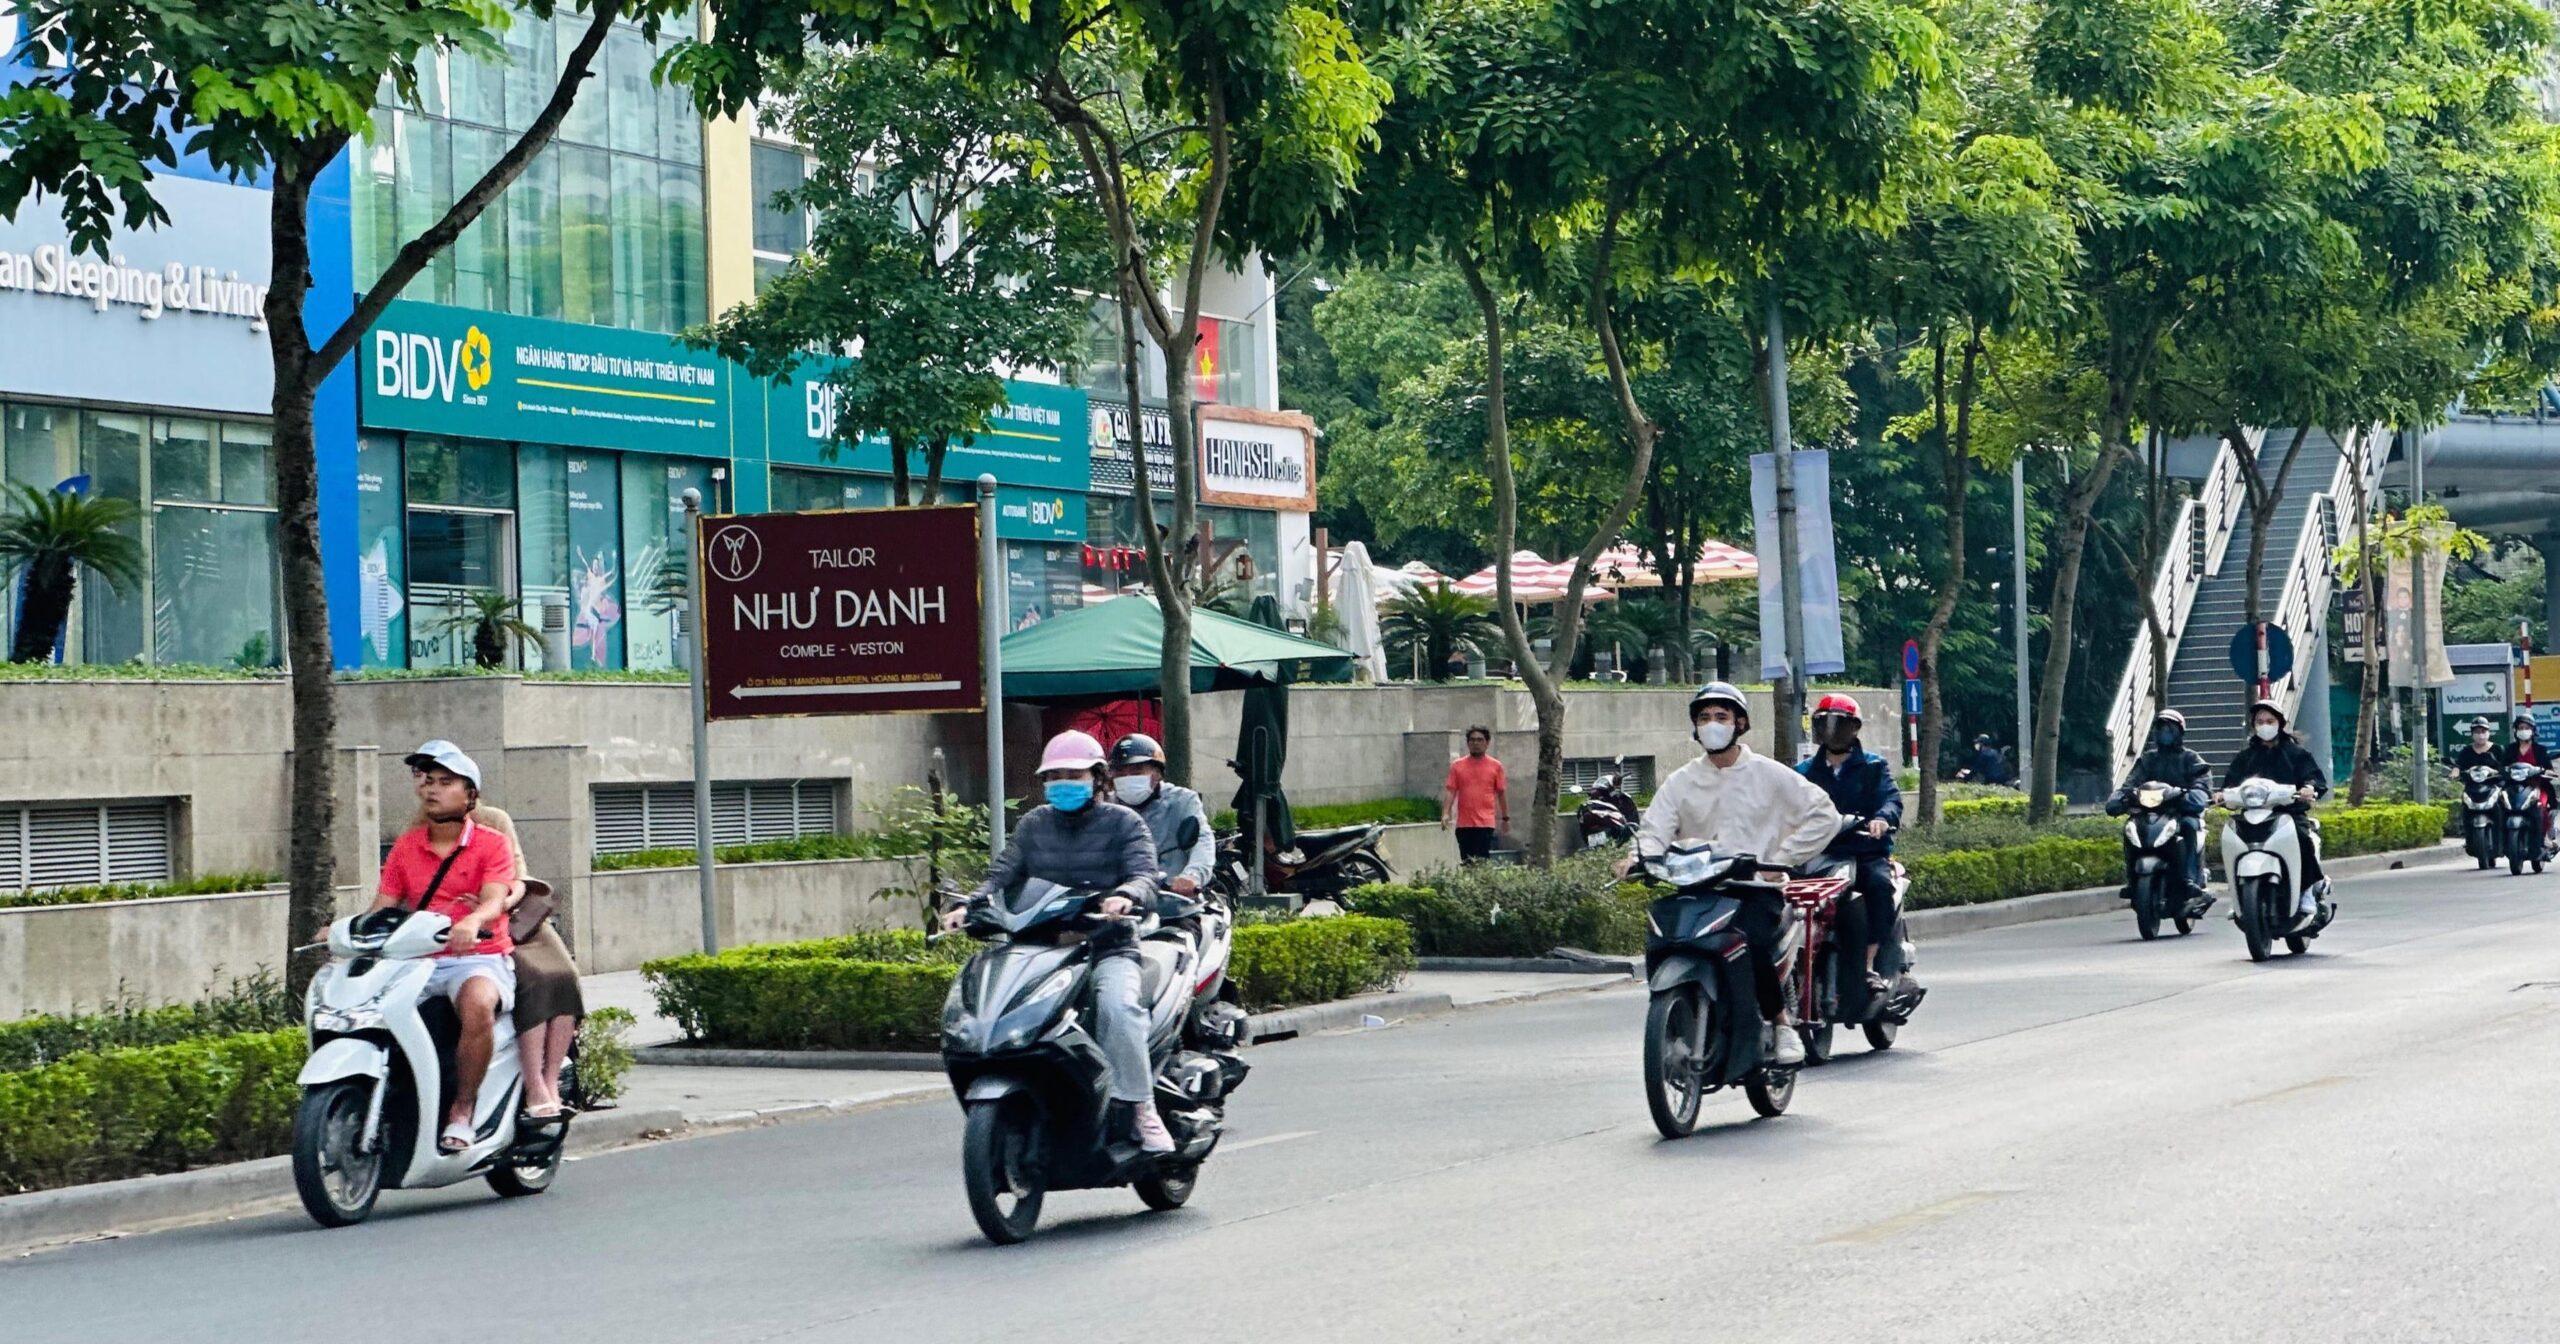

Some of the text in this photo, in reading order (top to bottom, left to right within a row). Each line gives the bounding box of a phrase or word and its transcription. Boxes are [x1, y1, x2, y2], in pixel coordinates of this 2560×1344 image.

[36, 244, 163, 320] Sleeping
[164, 261, 190, 310] &
[193, 264, 270, 333] Living
[376, 329, 463, 403] BIDV
[516, 344, 541, 366] NGÂN
[542, 346, 566, 370] HÀNG
[567, 353, 590, 374] TMCP
[634, 359, 654, 380] PHÁT
[679, 364, 696, 388] VIỆT
[697, 369, 715, 387] NAM
[1114, 410, 1156, 444] GAEN
[1208, 438, 1275, 479] HANASHI
[1032, 502, 1056, 525] BIDV
[808, 547, 876, 568] TAILOR
[733, 586, 946, 631] NHƯ DANH
[780, 645, 836, 658] COMPLE
[850, 641, 904, 656] VESTON
[2447, 694, 2502, 704] Vietcombank
